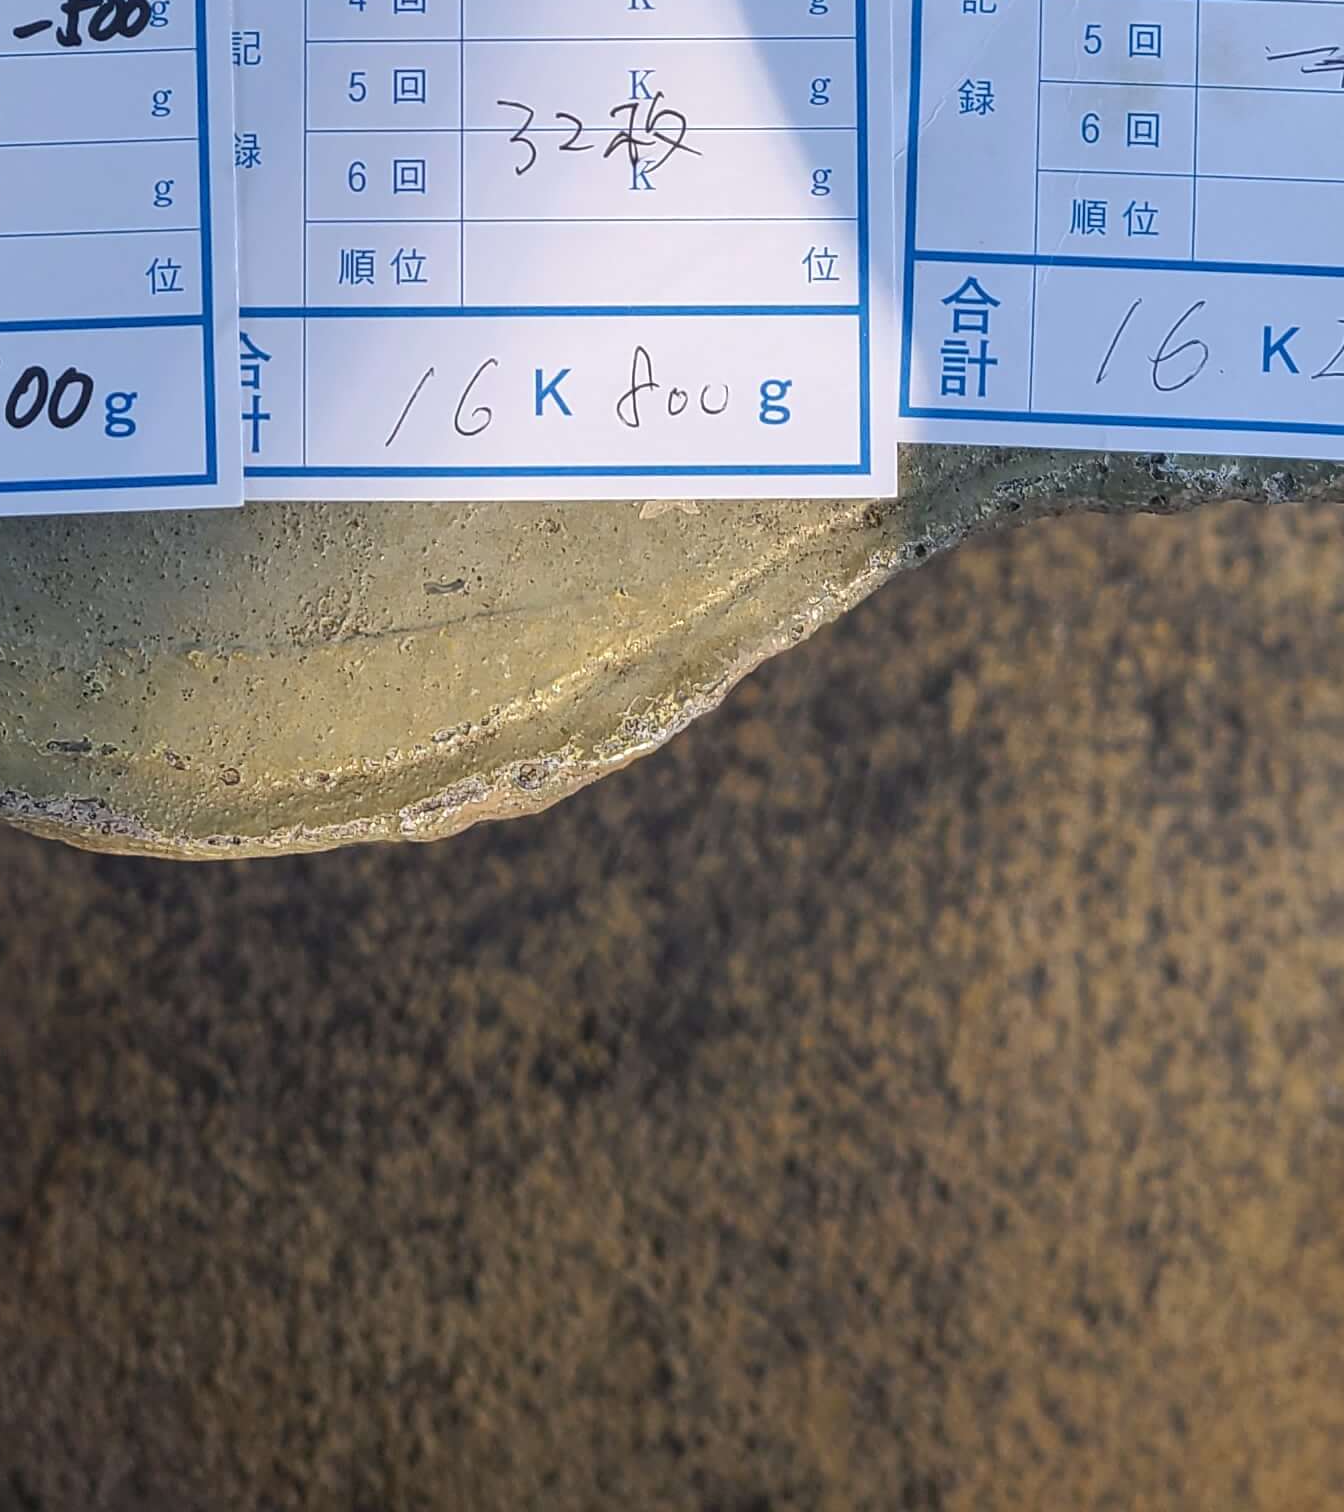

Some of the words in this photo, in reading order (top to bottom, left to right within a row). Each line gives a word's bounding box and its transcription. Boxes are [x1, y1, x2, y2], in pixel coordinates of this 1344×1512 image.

[1083, 23, 1162, 59] 5回
[348, 69, 426, 105] 5回
[1081, 112, 1160, 148] 6回
[348, 159, 426, 195] 6回
[1069, 199, 1159, 237] 順位
[145, 257, 185, 295] 位
[338, 247, 428, 286] 順位
[801, 246, 841, 284] 位
[940, 276, 1001, 398] 合計
[1262, 325, 1300, 374] K
[104, 391, 138, 438] g
[535, 368, 572, 417] K
[758, 379, 793, 425] g
